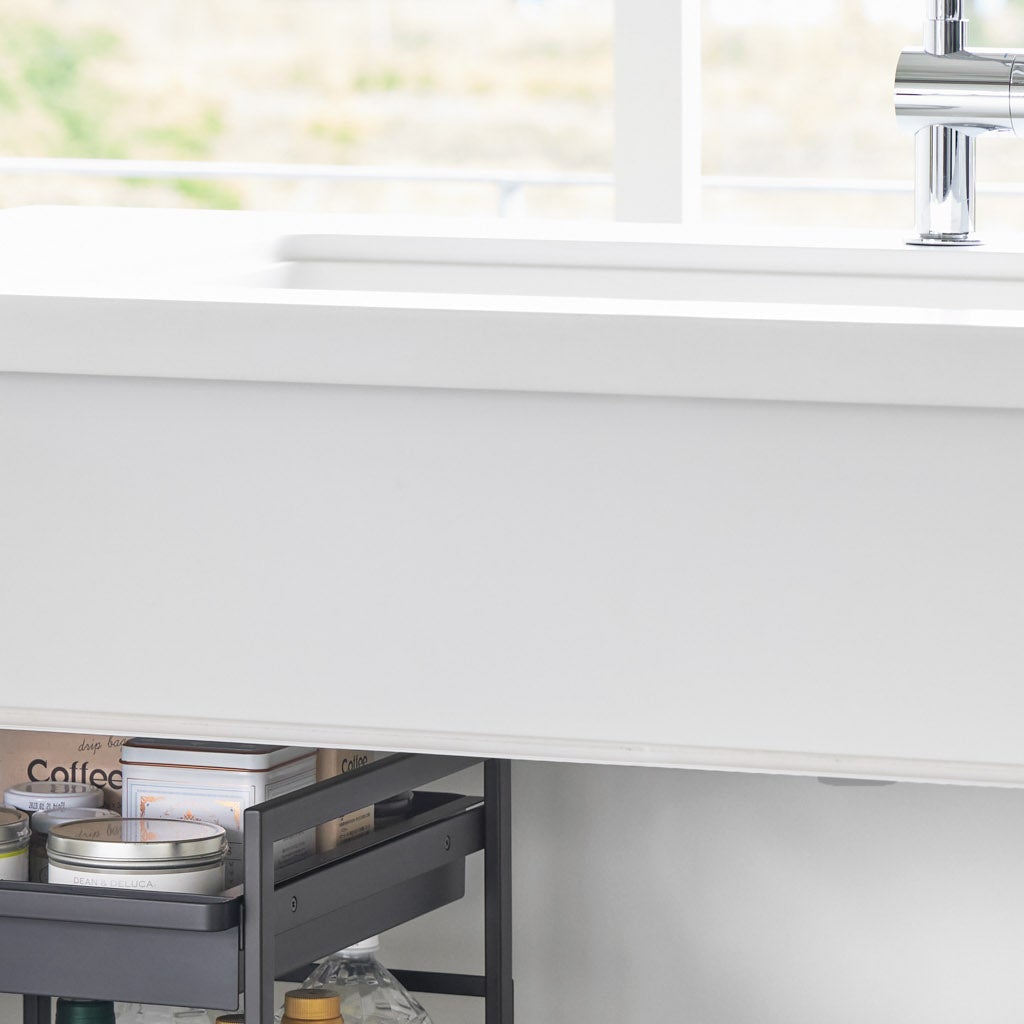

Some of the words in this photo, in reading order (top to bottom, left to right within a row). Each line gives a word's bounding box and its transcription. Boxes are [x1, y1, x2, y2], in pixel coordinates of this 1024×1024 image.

[78, 739, 102, 755] drip
[27, 759, 122, 789] Coffee
[73, 876, 98, 886] DEAN
[101, 879, 107, 887] &
[110, 880, 154, 888] DELUCA
